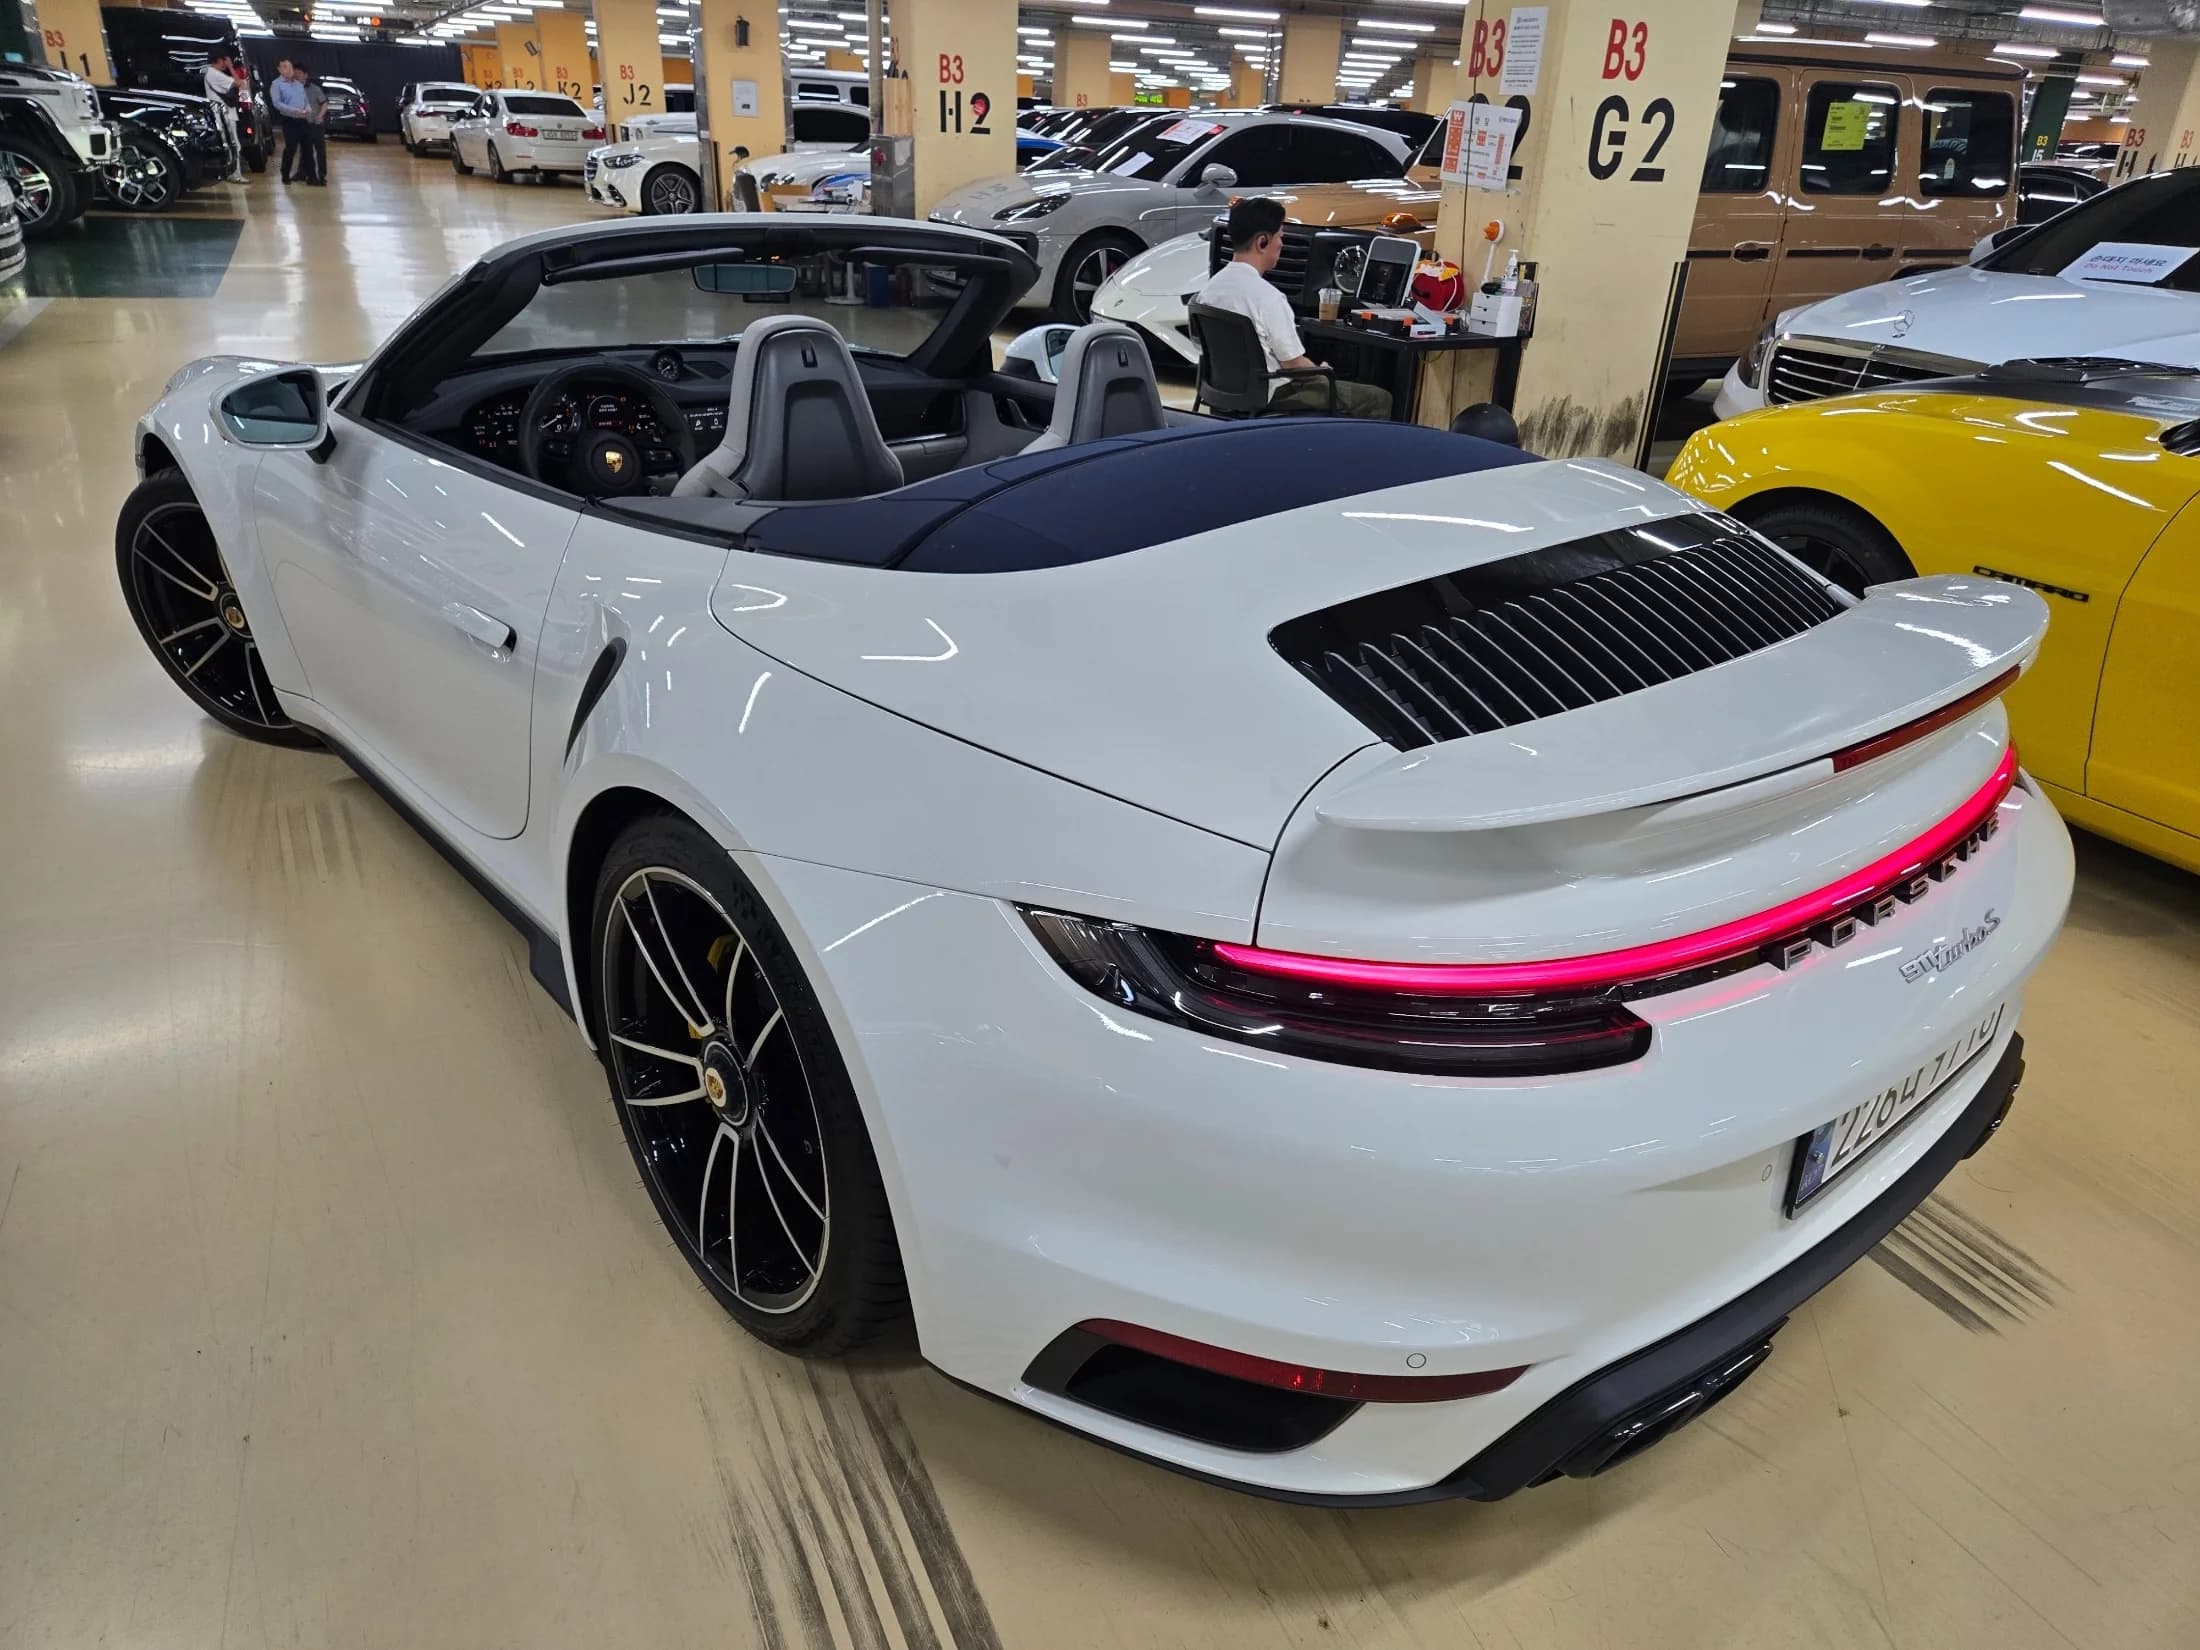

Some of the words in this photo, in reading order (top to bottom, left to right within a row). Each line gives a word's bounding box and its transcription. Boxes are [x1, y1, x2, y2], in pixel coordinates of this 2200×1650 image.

[45, 30, 64, 47] B3
[1468, 18, 1506, 78] B3
[1602, 18, 1648, 81] B3
[556, 66, 568, 79] B3
[620, 64, 635, 80] B3
[939, 54, 964, 84] B3
[558, 81, 582, 100] K2
[623, 83, 652, 106] J2
[1077, 93, 1088, 107] B3
[939, 90, 991, 135] H2
[1588, 95, 1675, 182] G2
[2036, 135, 2049, 146] B3
[2125, 128, 2147, 148] B3
[2180, 129, 2195, 149] B3
[1780, 811, 1999, 971] PORSCHE
